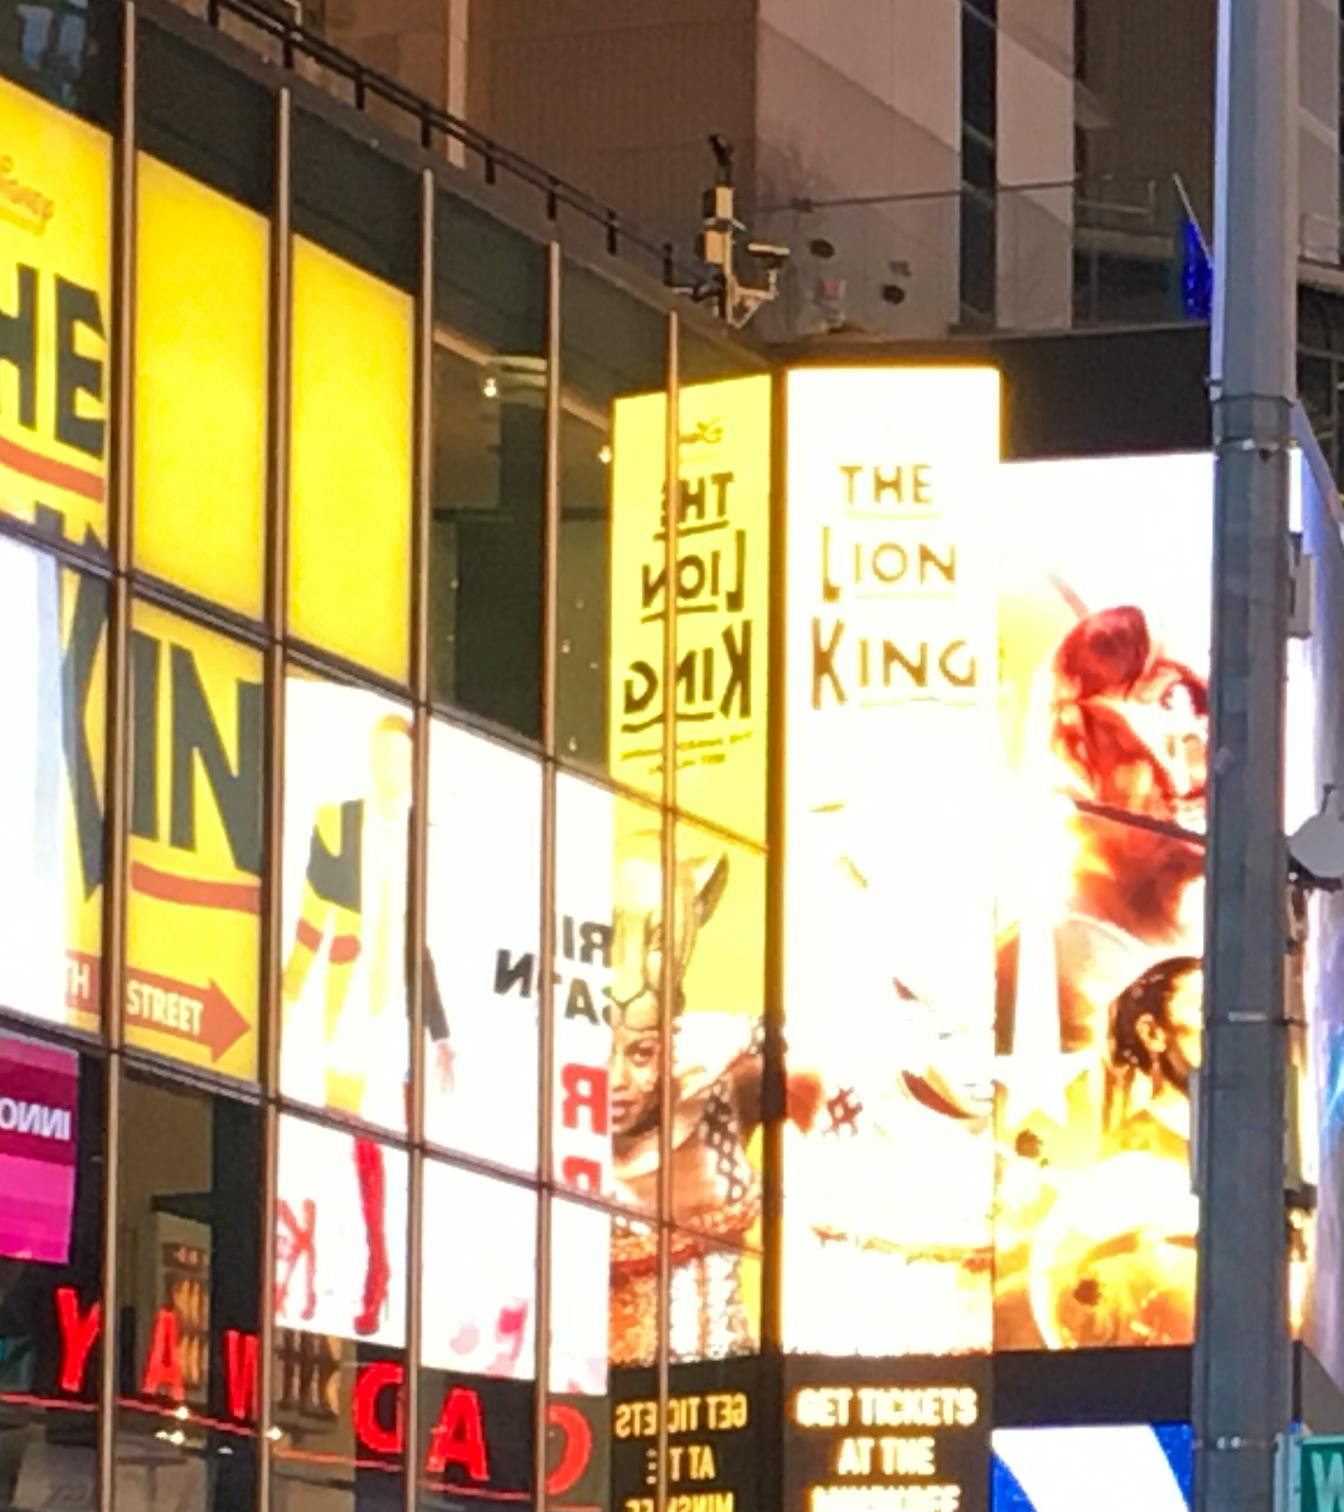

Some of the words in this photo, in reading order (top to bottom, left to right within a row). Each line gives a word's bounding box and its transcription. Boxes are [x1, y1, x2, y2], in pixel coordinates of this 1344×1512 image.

[839, 464, 935, 506] THE
[821, 525, 957, 604] LION
[810, 615, 977, 709] KING
[125, 978, 204, 1037] STREET
[796, 1387, 852, 1427] GET
[858, 1386, 977, 1428] TICKETS
[836, 1436, 875, 1477] AT
